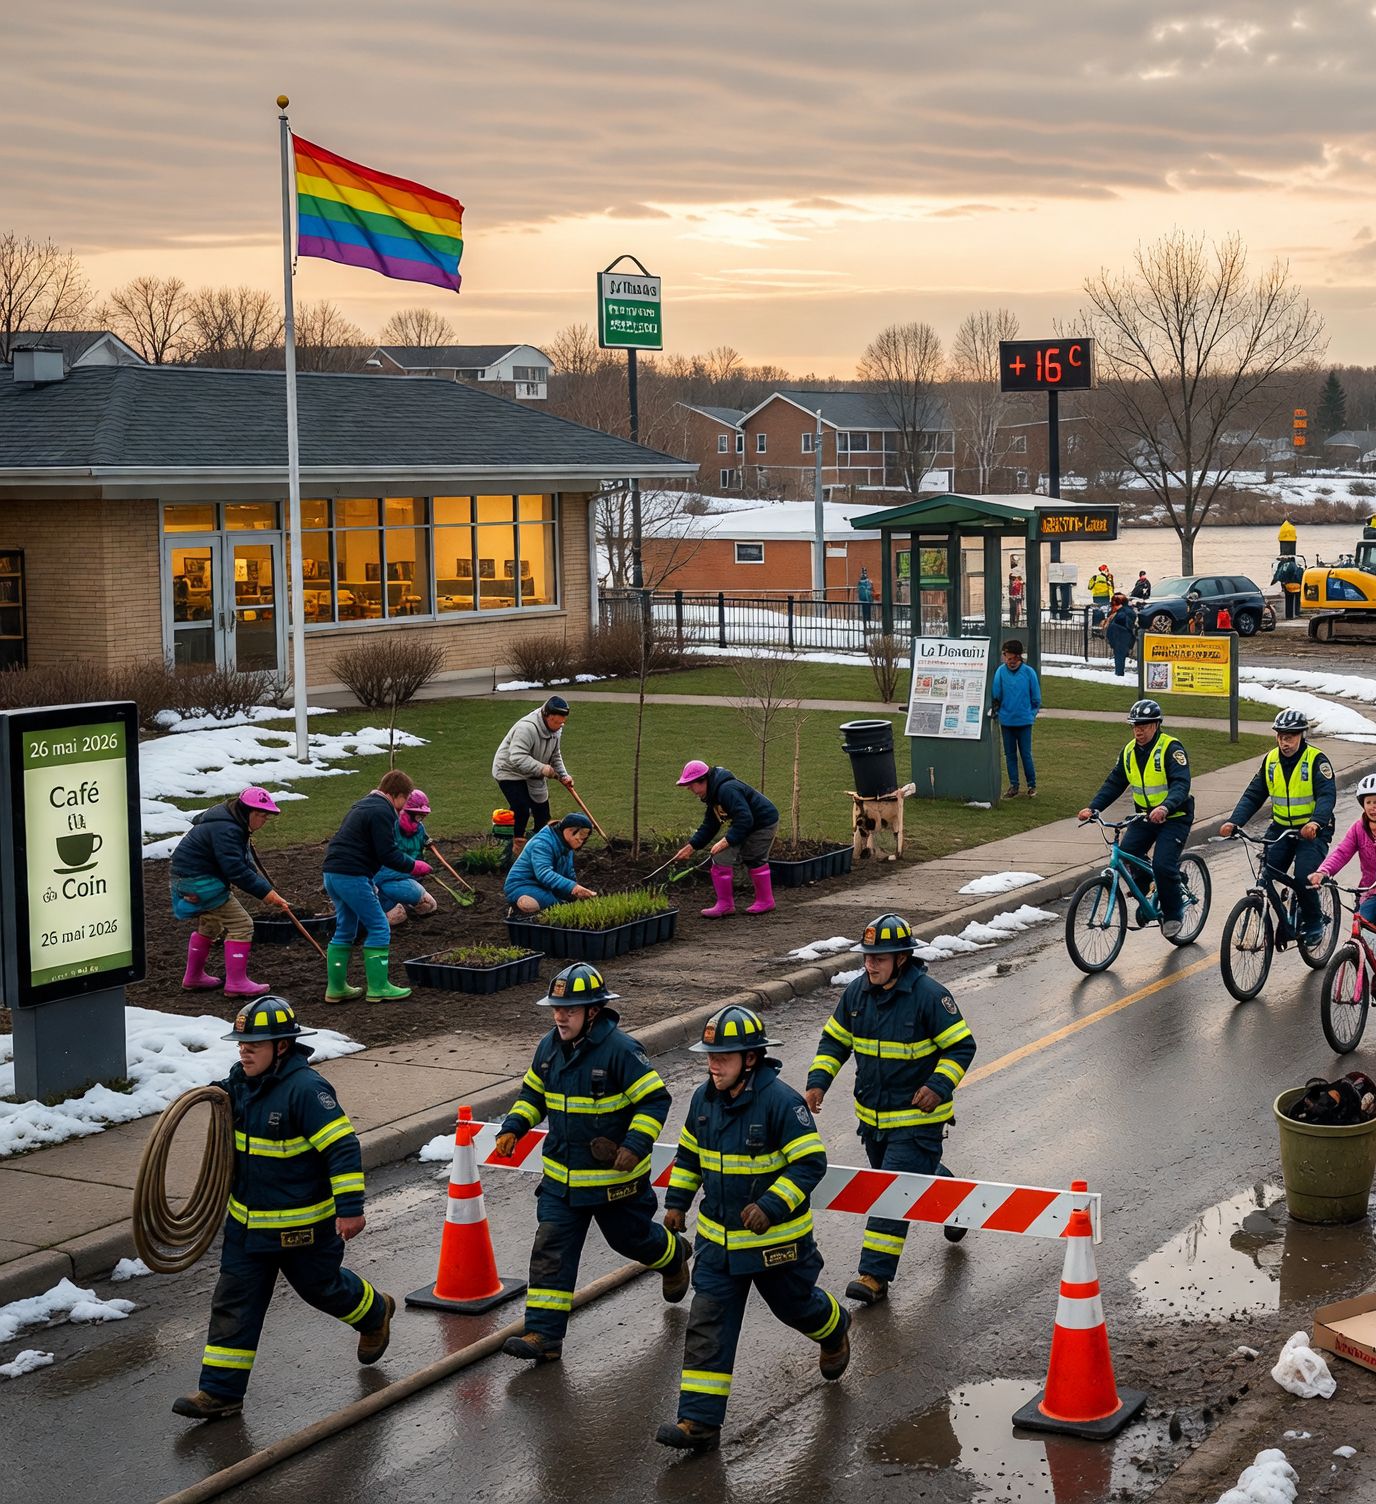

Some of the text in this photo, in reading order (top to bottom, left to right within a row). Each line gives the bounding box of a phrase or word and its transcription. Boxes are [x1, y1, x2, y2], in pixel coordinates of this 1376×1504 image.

[30, 733, 118, 758] 26 mai 2026
[49, 780, 100, 808] Café
[62, 874, 107, 900] Coin
[41, 919, 118, 948] 26 mai 2026
